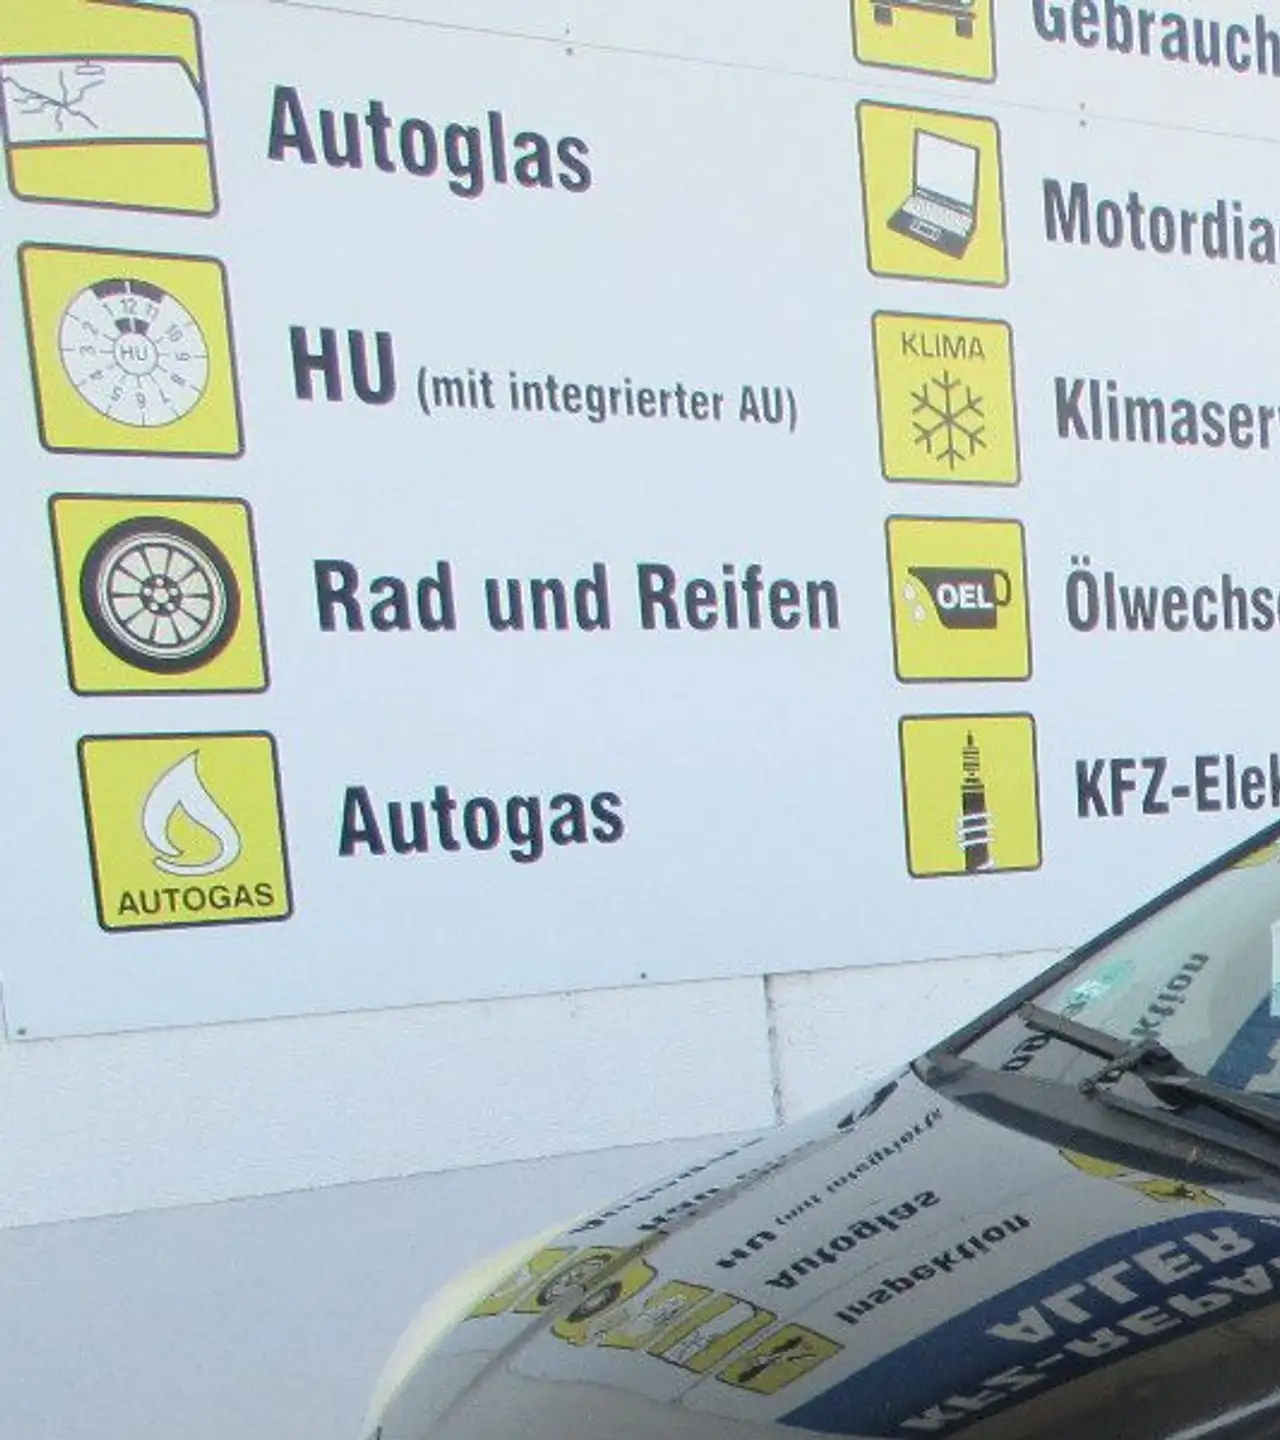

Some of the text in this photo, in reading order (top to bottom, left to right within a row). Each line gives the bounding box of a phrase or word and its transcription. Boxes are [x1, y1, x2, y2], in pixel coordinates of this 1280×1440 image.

[268, 84, 592, 199] Autoglas
[120, 346, 148, 361] HU
[902, 332, 985, 360] KLIMA
[289, 326, 798, 434] HU (mit integrierter AU)
[314, 558, 841, 632] Rad und Reifen
[937, 582, 994, 610] OEL
[339, 785, 626, 862] Autogas
[118, 882, 273, 916] AUTOGAS
